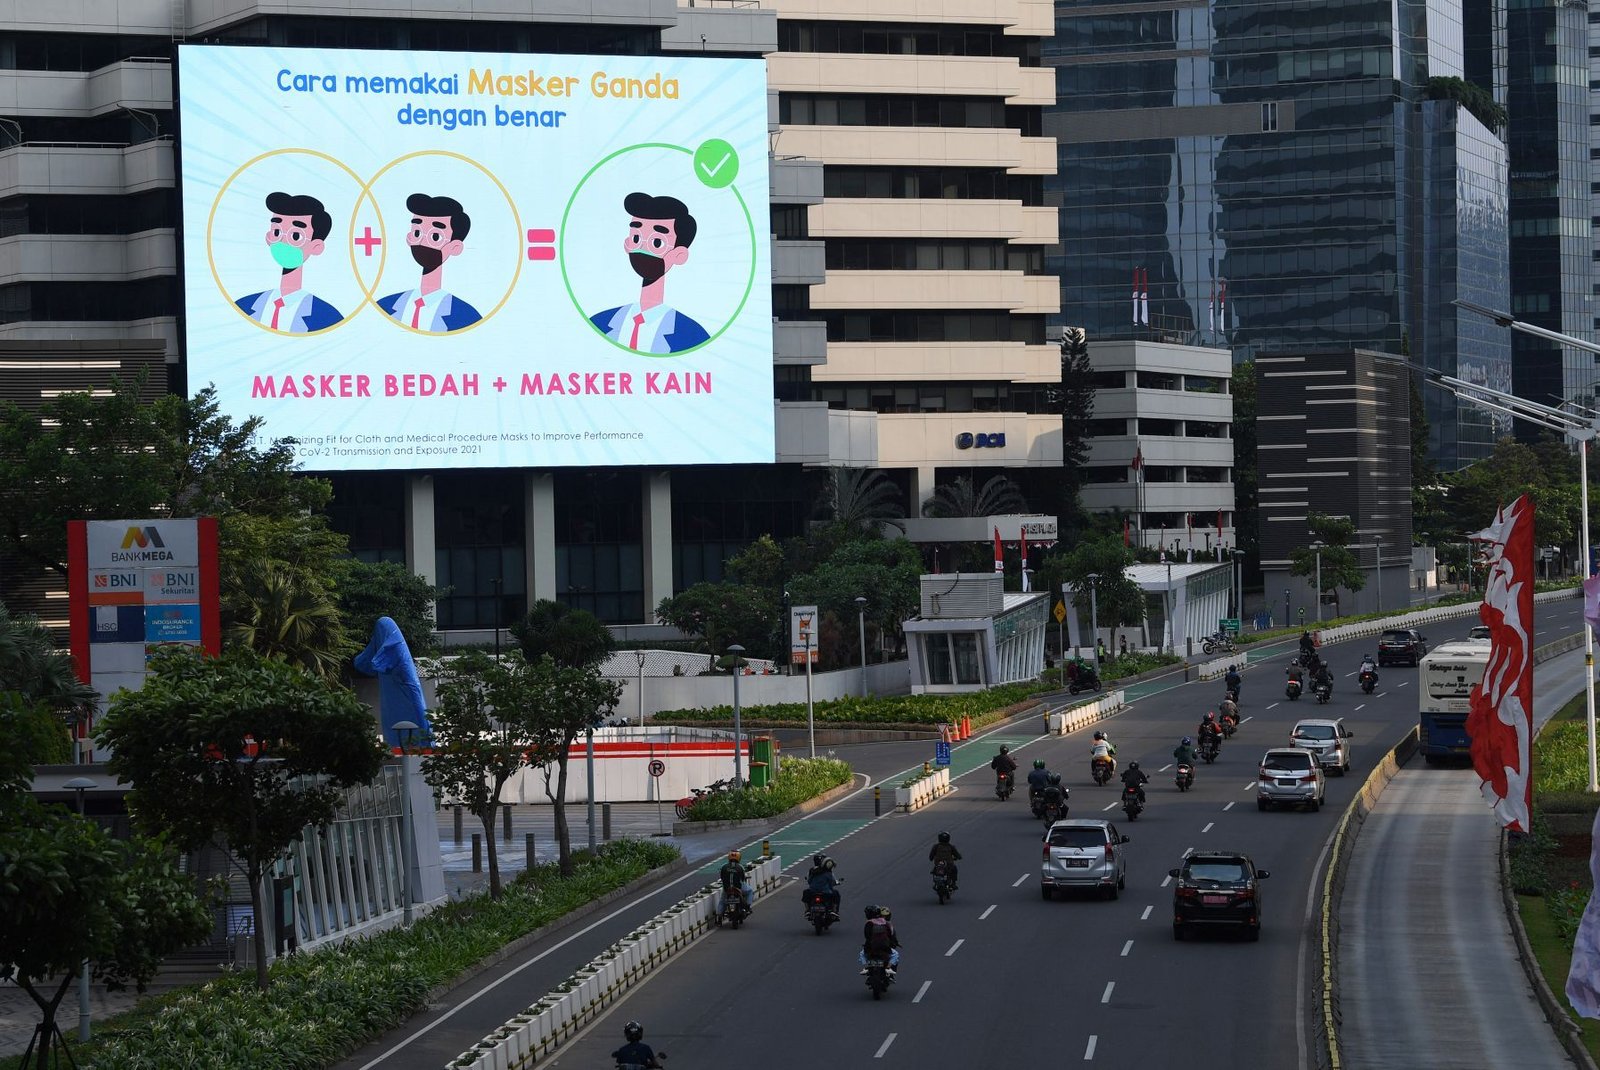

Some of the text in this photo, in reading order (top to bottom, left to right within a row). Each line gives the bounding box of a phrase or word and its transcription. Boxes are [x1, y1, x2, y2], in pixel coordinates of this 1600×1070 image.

[277, 69, 679, 100] Cara memakai Masker Ganda
[397, 103, 567, 131] dengan benar
[252, 375, 371, 398] MASKER
[385, 374, 479, 397] BEDAH
[521, 373, 633, 396] MASKER
[646, 373, 712, 394] KAIN
[326, 435, 337, 444] Fit
[339, 434, 353, 444] for
[355, 434, 382, 444] Cloth
[384, 434, 404, 443] and
[407, 434, 446, 443] Medical
[449, 433, 498, 442] Procedure
[501, 433, 529, 442] Masks
[531, 432, 541, 441] to
[543, 432, 582, 443] Improve
[584, 431, 644, 441] Performance
[299, 447, 331, 457] CoV-2
[333, 446, 392, 456] Transmission
[394, 445, 414, 455] and
[416, 445, 458, 456] Exposure
[461, 445, 482, 454] 2021
[110, 574, 137, 587] BNI
[167, 573, 195, 586] BNI
[161, 587, 195, 595] Sekuritas
